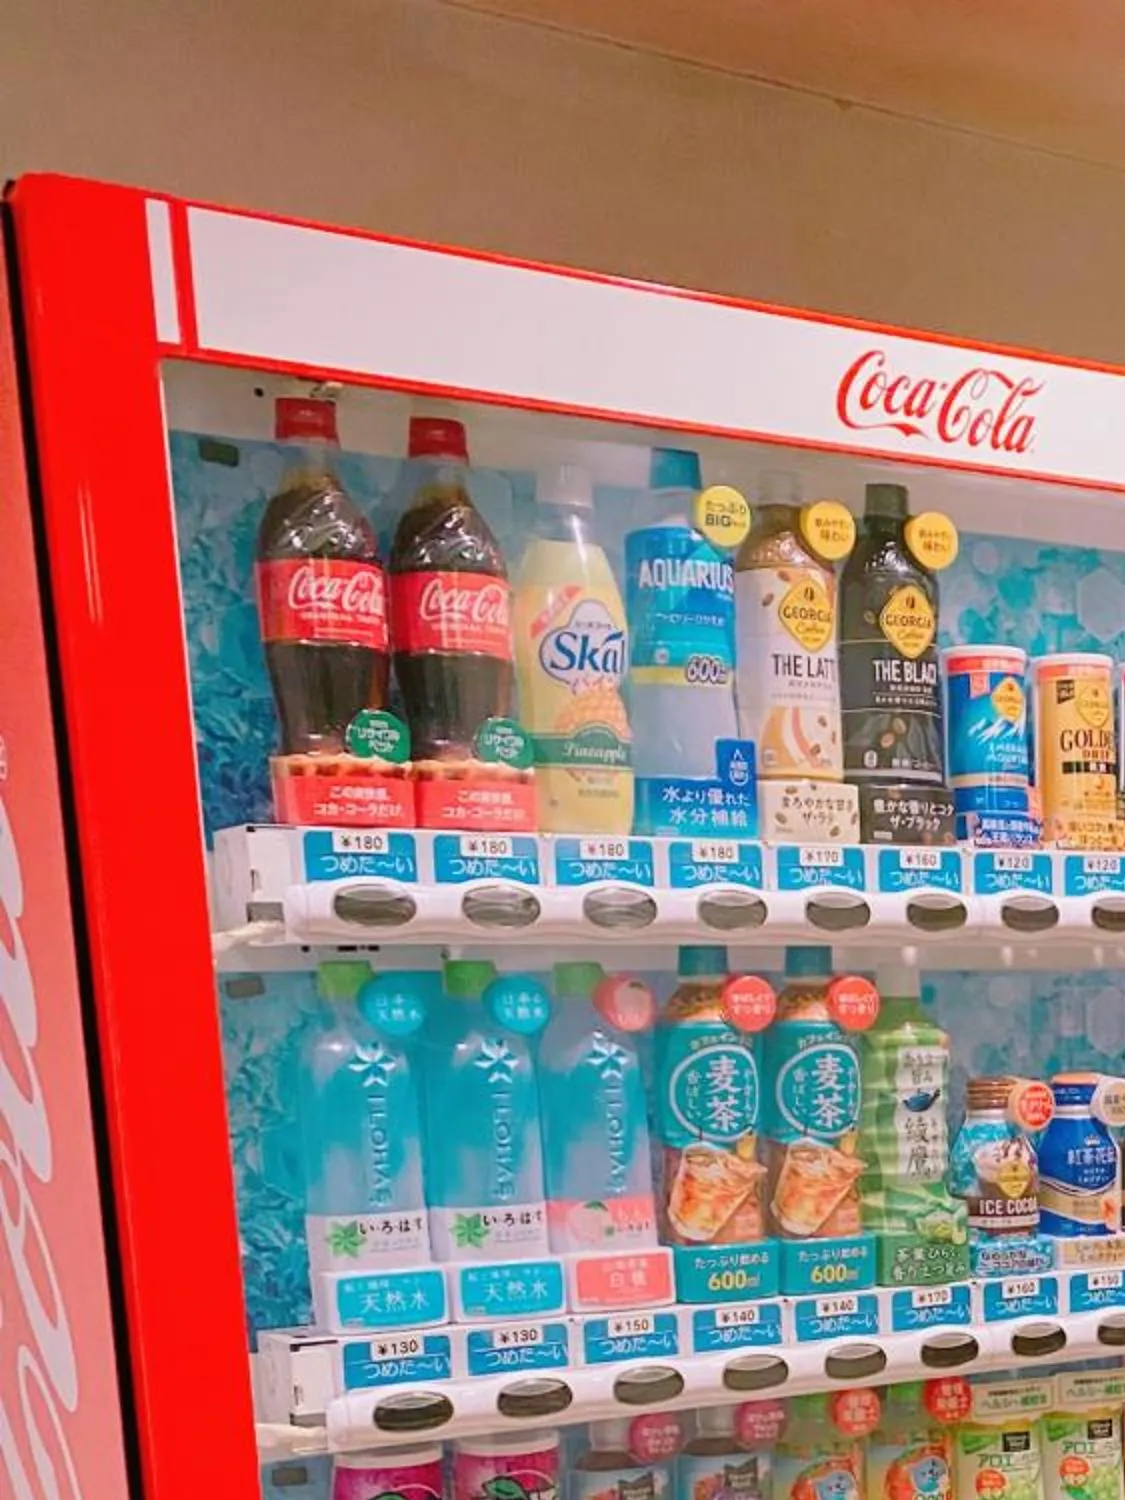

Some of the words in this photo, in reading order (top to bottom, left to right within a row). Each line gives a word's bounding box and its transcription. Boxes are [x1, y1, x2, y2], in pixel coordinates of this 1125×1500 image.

[837, 349, 1045, 454] Coca-Cola
[638, 558, 735, 592] AQUARIUS
[772, 654, 803, 678] THE
[807, 656, 836, 679] LATT
[873, 660, 900, 682] THE
[663, 786, 751, 807] 水より優れた
[669, 808, 749, 828] 水分補給
[341, 836, 383, 850] ¥180
[469, 841, 507, 854] ¥180
[588, 843, 624, 856] ¥180
[700, 846, 733, 860] ¥180
[705, 1055, 742, 1131] 麦茶
[810, 1054, 845, 1128] 麦茶
[979, 1200, 1004, 1215] ICE
[484, 1280, 548, 1302] 天然水
[360, 1291, 429, 1313] 天然水
[614, 1319, 650, 1332] ¥150
[500, 1329, 539, 1343] ¥130
[377, 1340, 419, 1356] ¥130
